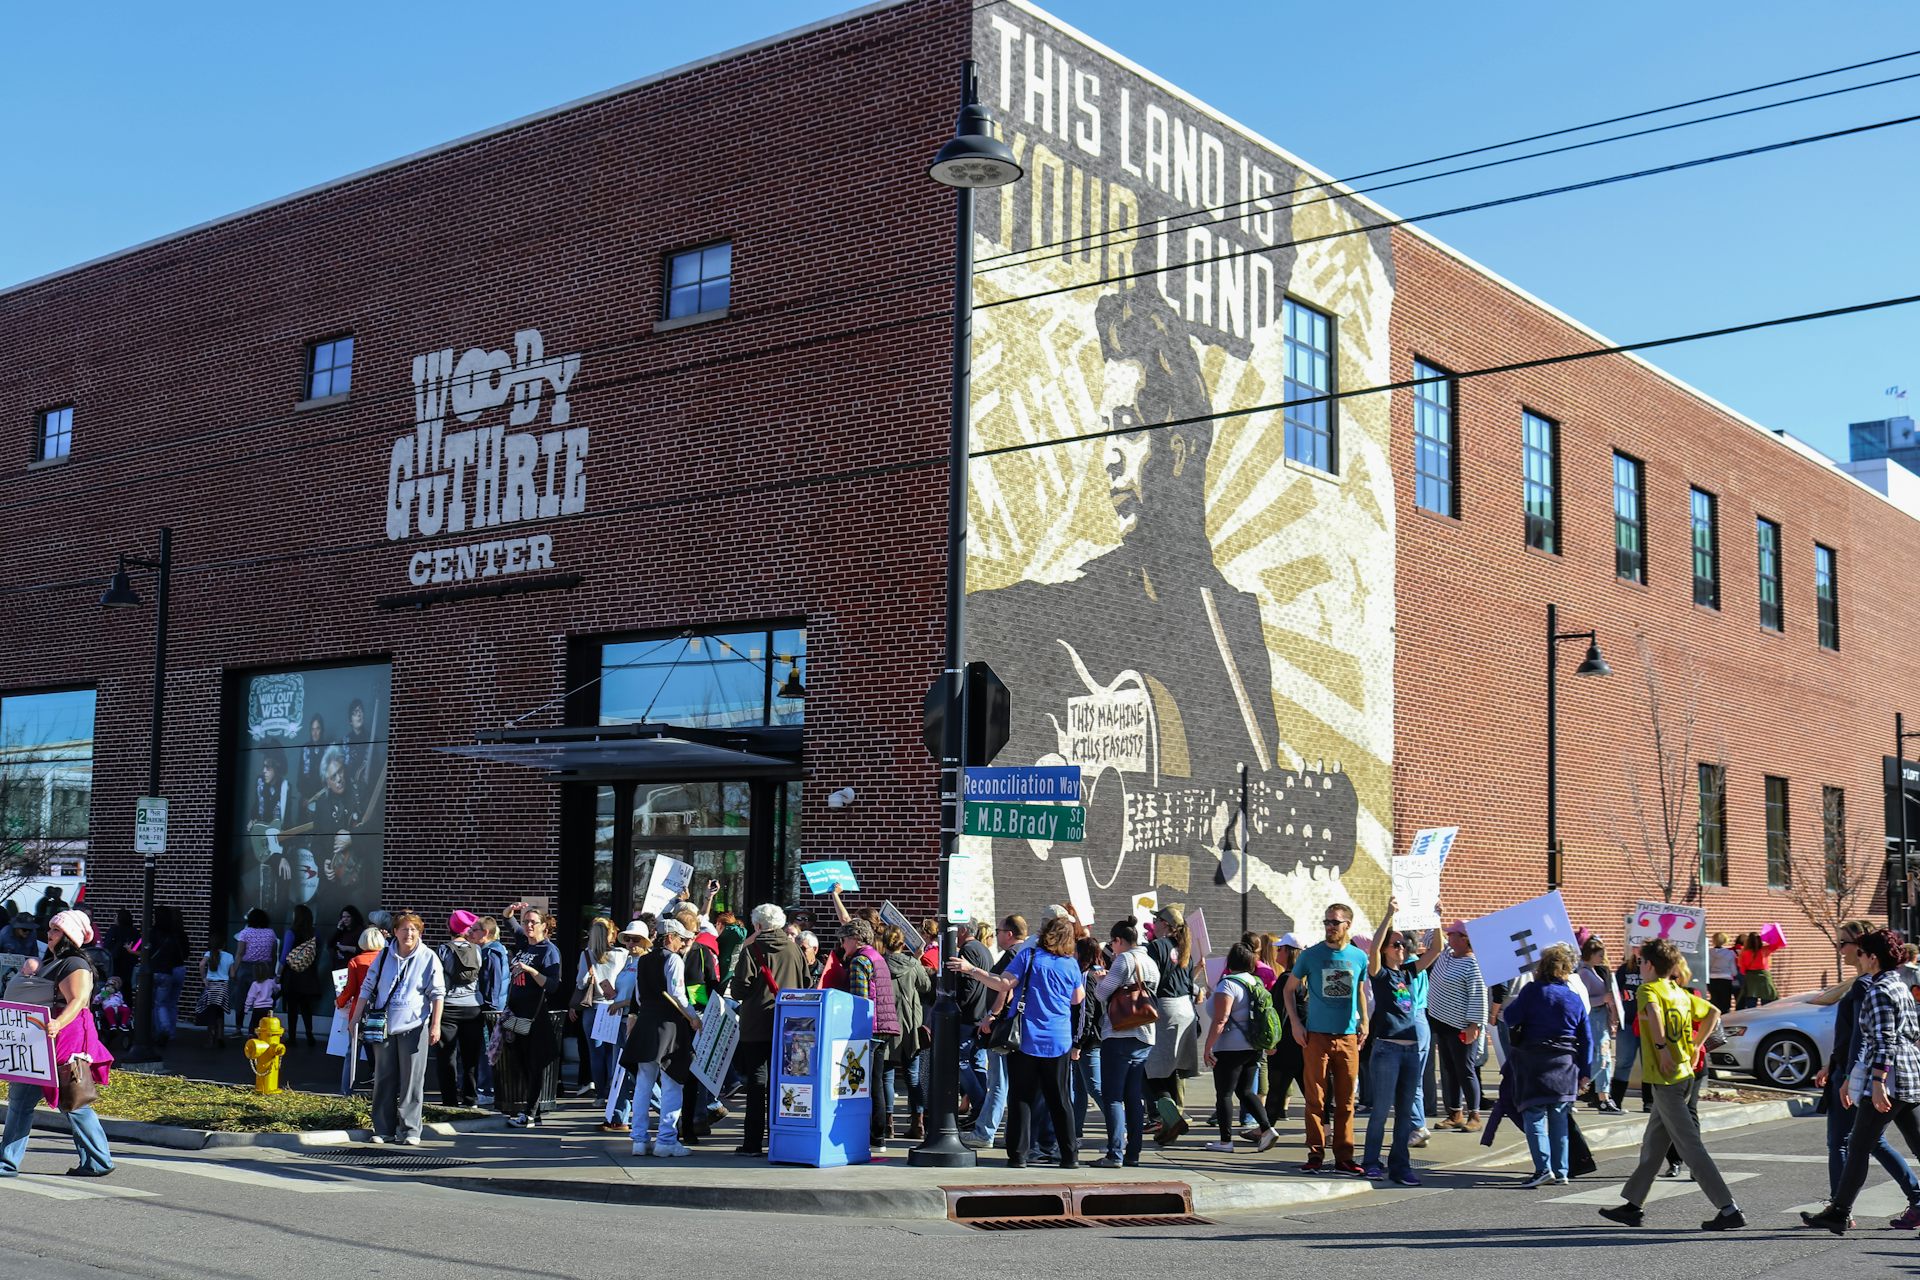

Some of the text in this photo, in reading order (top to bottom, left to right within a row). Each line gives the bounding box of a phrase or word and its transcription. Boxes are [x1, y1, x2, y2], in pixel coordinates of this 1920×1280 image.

[992, 15, 1275, 245] THIS LAND IS
[994, 121, 1275, 340] YOUR LAND
[412, 328, 582, 475] WOODY
[385, 424, 589, 540] GUTHRIE
[408, 534, 555, 585] CENTER
[259, 691, 294, 704] WAY OUT
[261, 702, 291, 718] WEST
[1070, 701, 1144, 732] THIS MACHINE
[1072, 733, 1143, 764] KILLS FASCISTS
[964, 774, 1079, 798] Reconciliation Way
[138, 811, 146, 822] 2
[1070, 808, 1081, 823] St
[1067, 826, 1081, 840] 100
[1638, 903, 1702, 917] THIS MACHINE
[0, 1008, 32, 1028] IGHT
[20, 1032, 26, 1042] A
